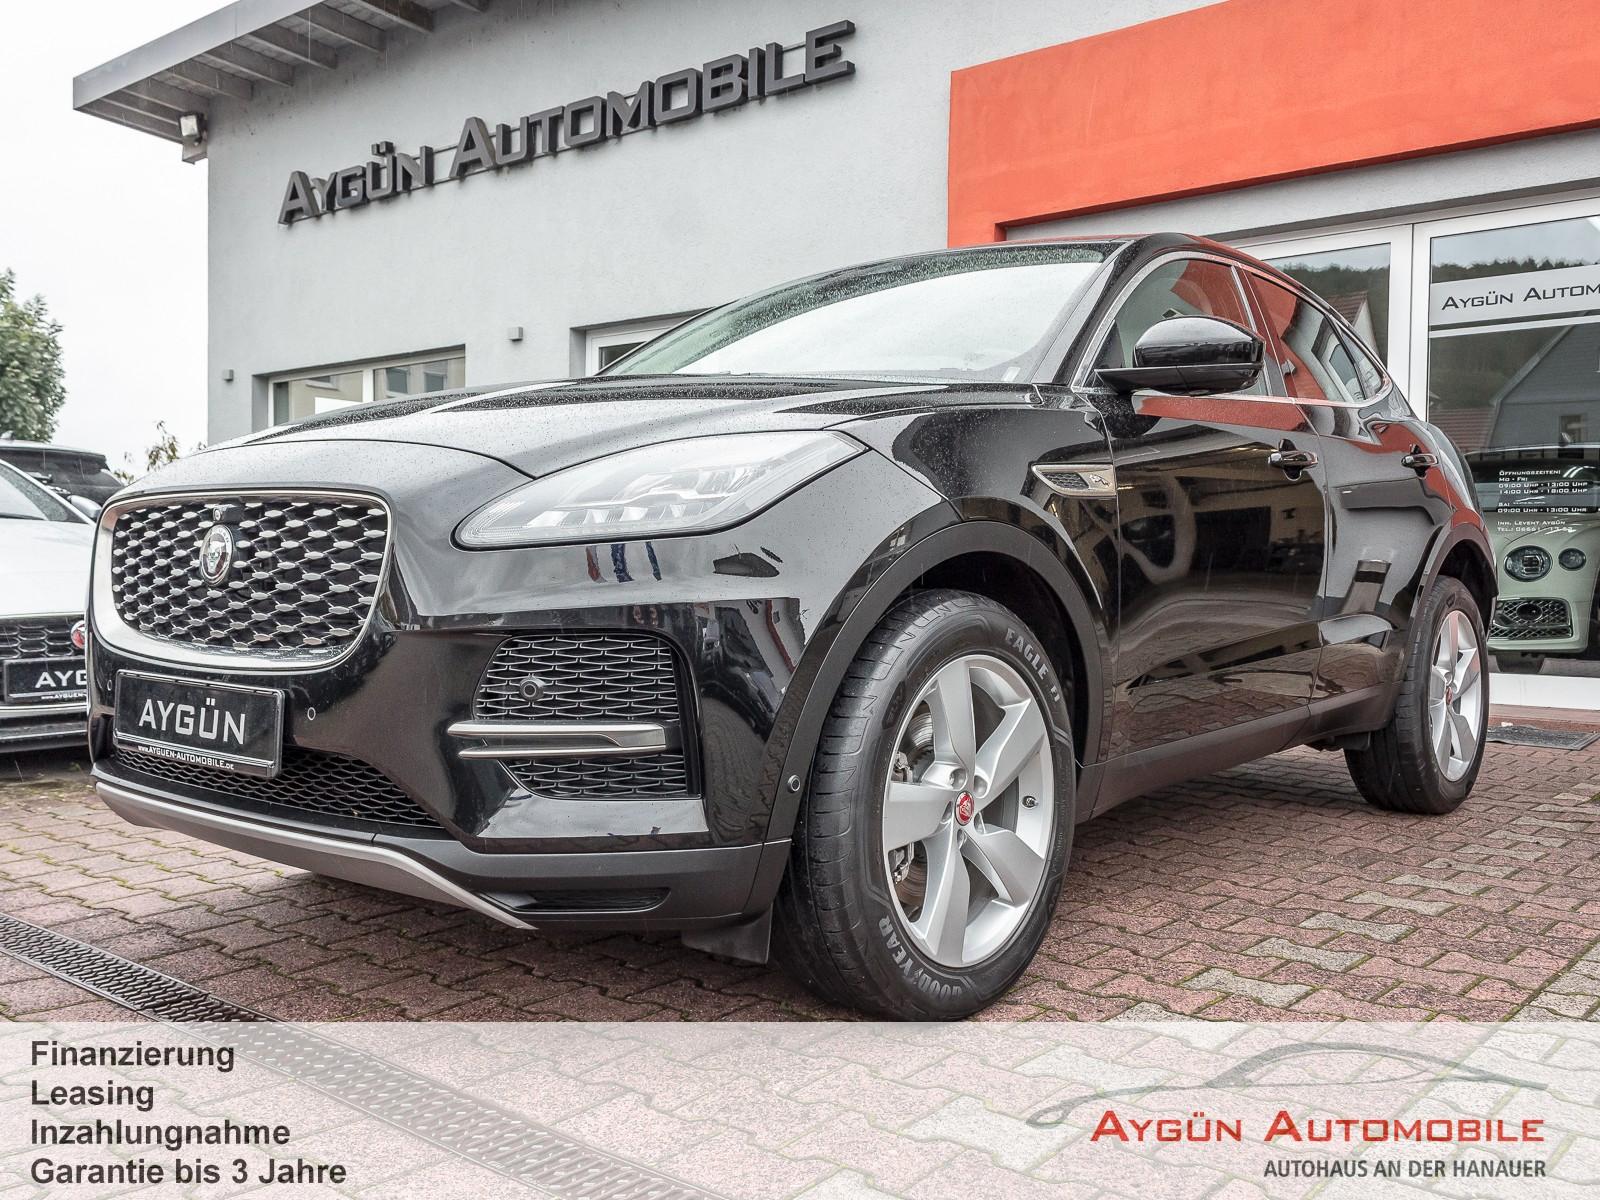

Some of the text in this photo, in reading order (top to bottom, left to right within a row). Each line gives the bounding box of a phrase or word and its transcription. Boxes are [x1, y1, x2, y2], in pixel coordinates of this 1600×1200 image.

[449, 20, 856, 179] AUTOMOBILE
[1441, 290, 1514, 311] AYGÜN
[1005, 628, 1049, 680] EAGLE
[138, 697, 246, 745] AYGÜN
